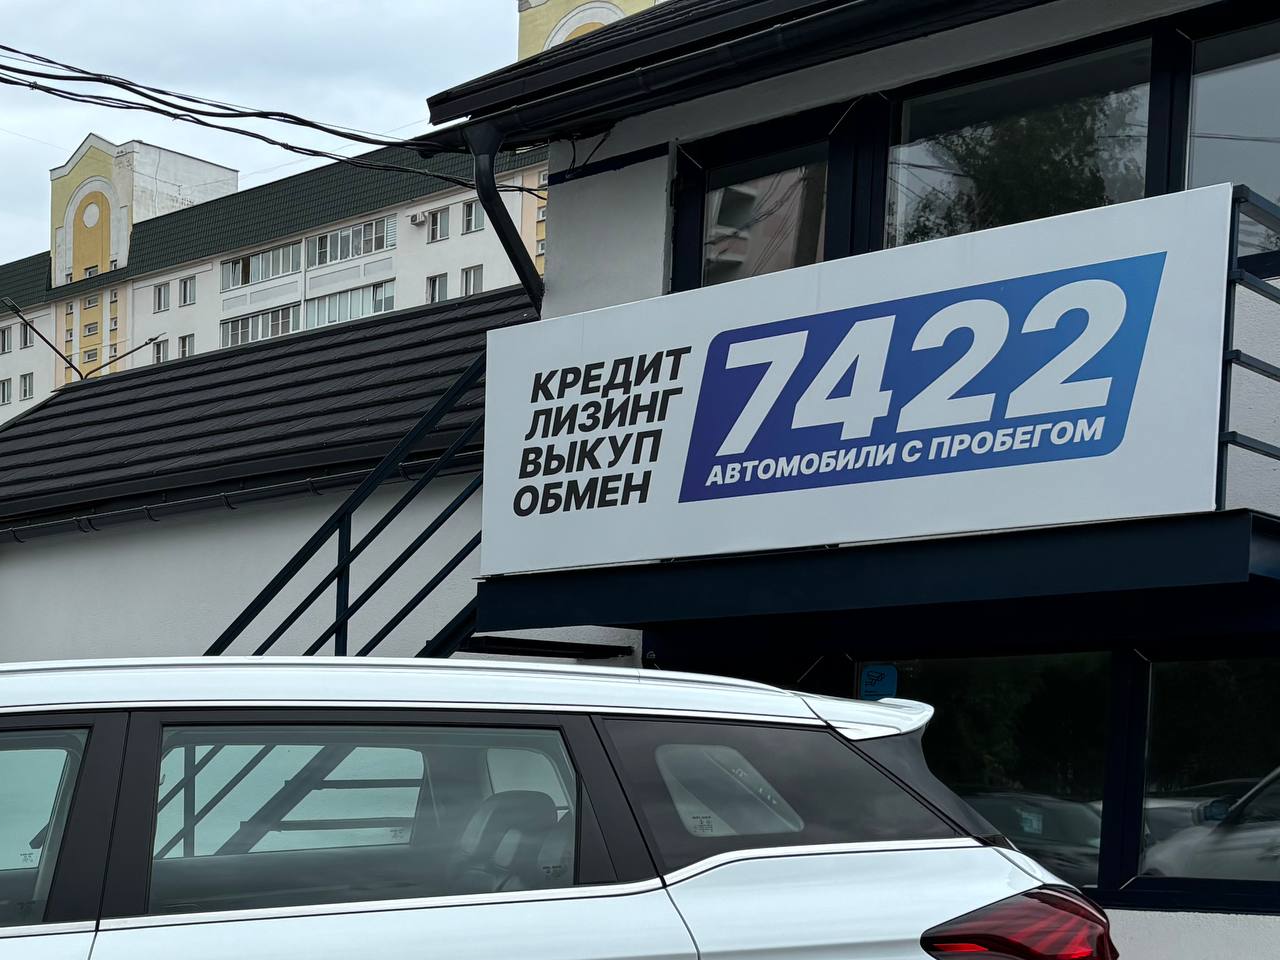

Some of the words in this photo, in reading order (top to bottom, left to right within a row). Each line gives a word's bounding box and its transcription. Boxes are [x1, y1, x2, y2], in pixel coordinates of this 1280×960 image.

[531, 346, 692, 403] КРЕДИТ
[715, 279, 1127, 457] 7422
[524, 387, 683, 440] ЛИЗИНГ
[518, 429, 663, 479] ВЫКУП
[705, 442, 897, 486] АВТОМОБИЛИ
[901, 440, 923, 463] С
[928, 416, 1106, 460] ПРОБЕГОМ
[513, 470, 652, 517] ОБМЕН
